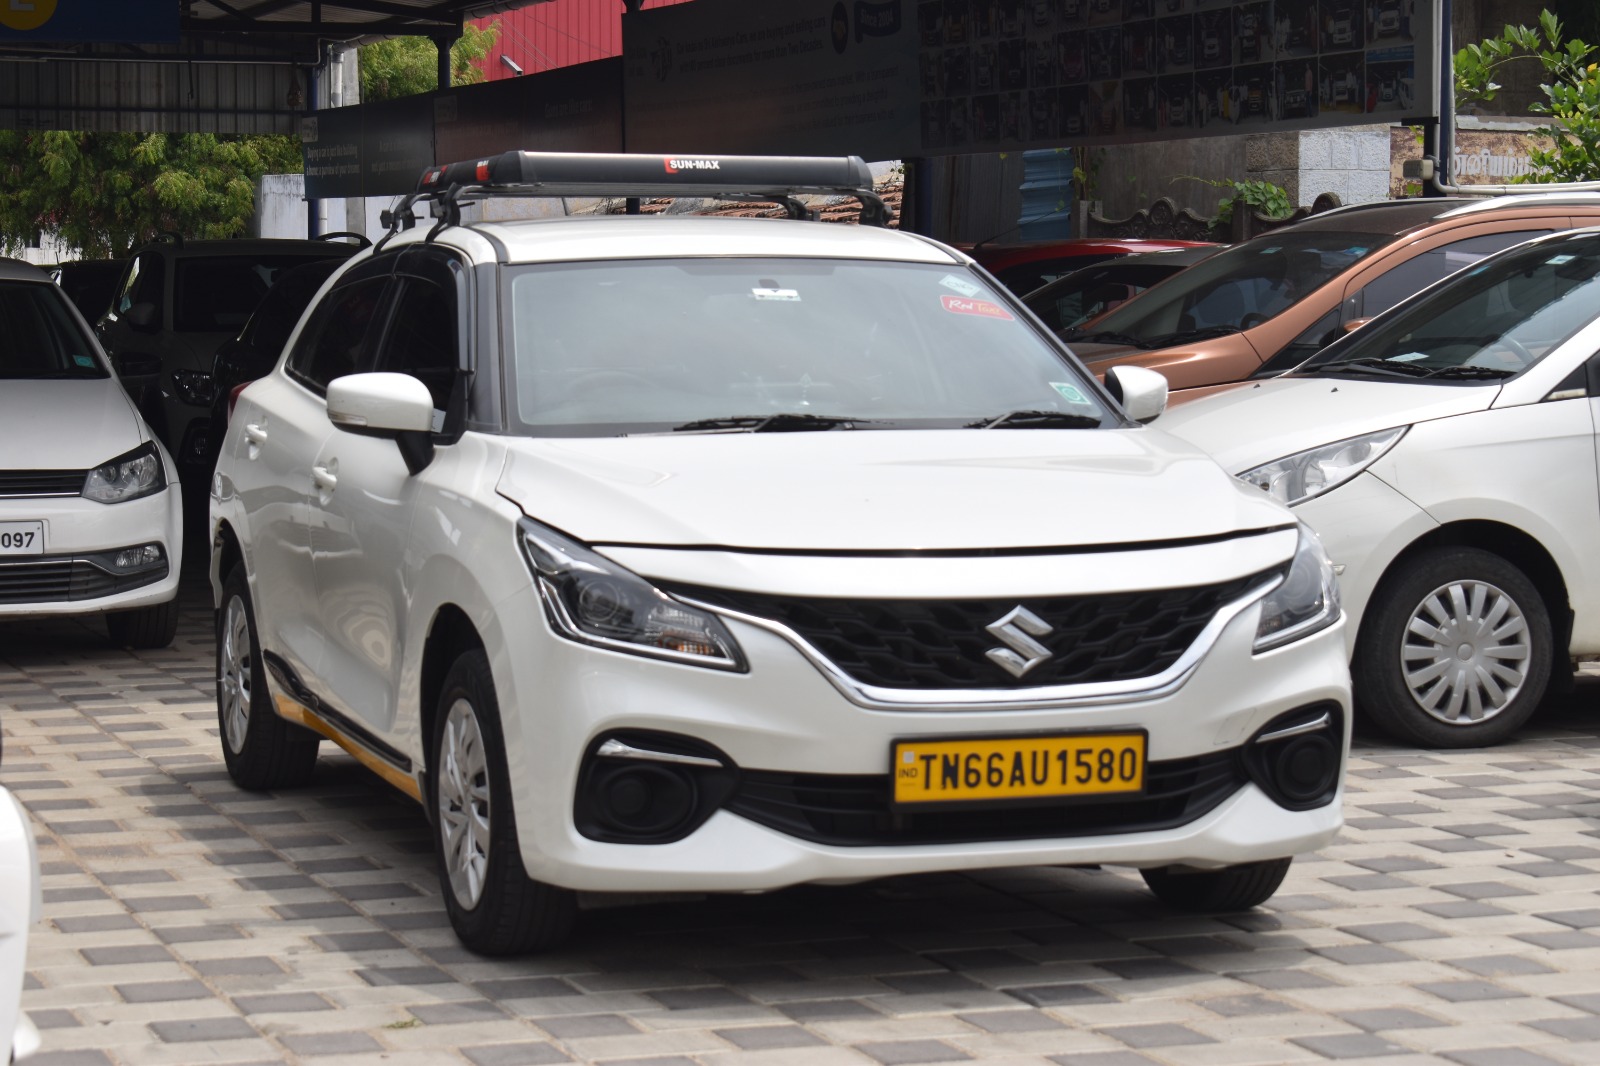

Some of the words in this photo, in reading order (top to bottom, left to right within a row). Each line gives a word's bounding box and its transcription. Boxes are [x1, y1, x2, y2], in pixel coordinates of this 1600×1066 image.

[669, 159, 720, 170] SUN-MAX
[948, 299, 973, 310] Red
[1, 531, 35, 549] 097
[898, 767, 919, 778] IND
[919, 747, 1138, 790] TN66AU1580
